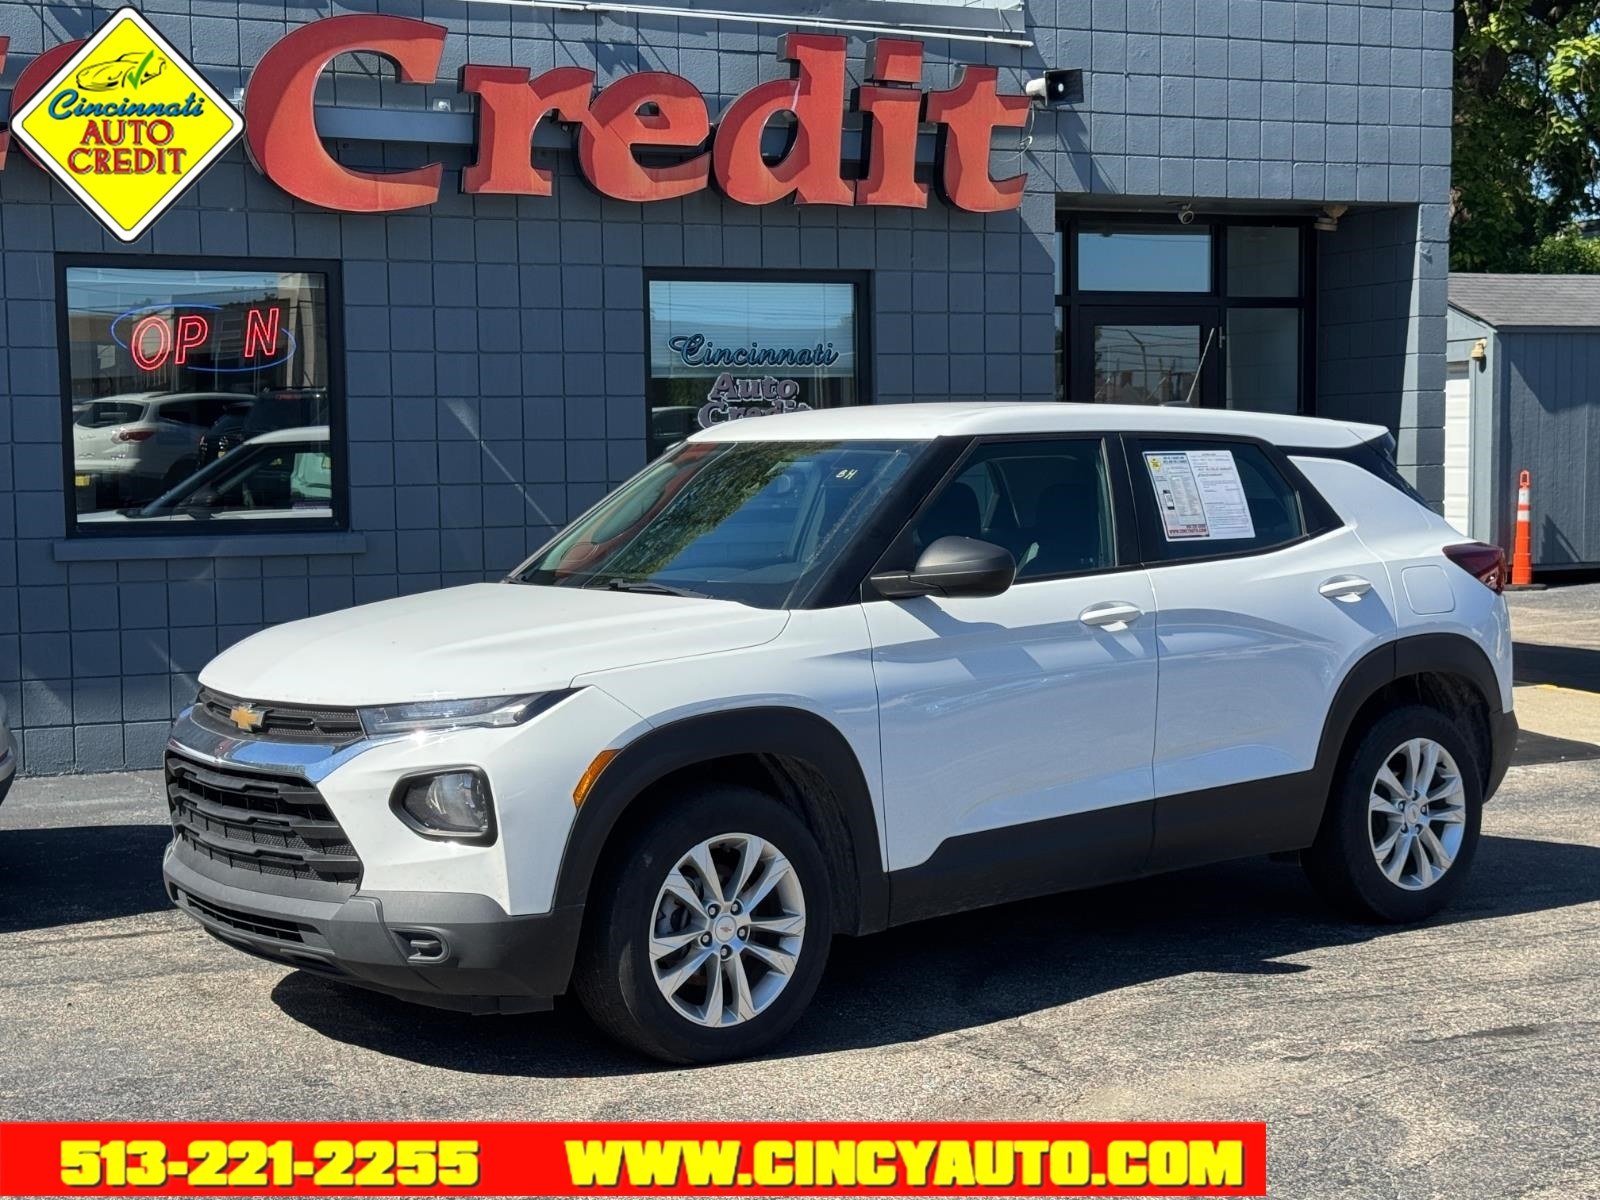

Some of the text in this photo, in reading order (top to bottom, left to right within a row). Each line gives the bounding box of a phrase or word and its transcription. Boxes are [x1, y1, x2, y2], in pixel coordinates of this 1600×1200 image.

[243, 14, 1030, 214] Credit
[668, 333, 839, 368] Cincinnati
[707, 372, 800, 402] Auto
